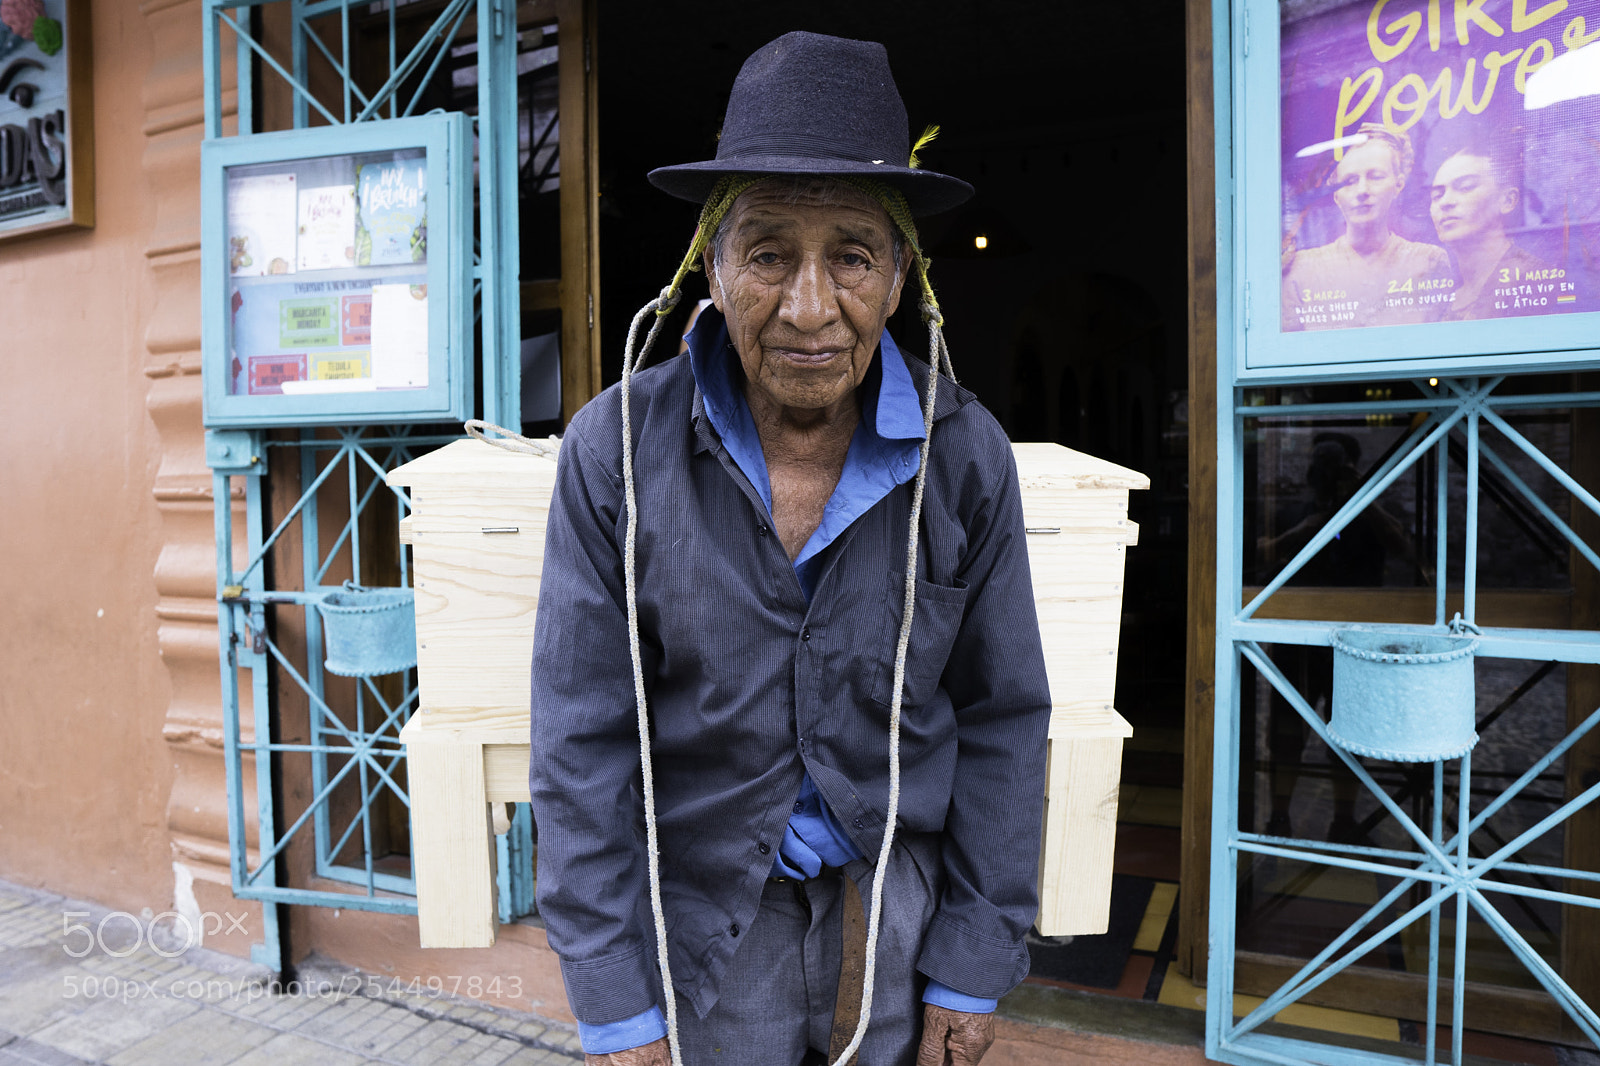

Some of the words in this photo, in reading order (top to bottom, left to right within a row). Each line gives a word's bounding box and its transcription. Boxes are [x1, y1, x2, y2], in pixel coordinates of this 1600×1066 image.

[1498, 267, 1520, 283] 31
[1525, 268, 1566, 281] MARZO
[1387, 277, 1413, 294] 24
[1418, 278, 1454, 290] MARZO
[1494, 284, 1532, 297] FIESTA
[1537, 282, 1555, 294] VIP
[1560, 281, 1575, 292] EN
[1302, 289, 1312, 302] 3
[1313, 290, 1347, 301] MARZO
[1385, 297, 1414, 307] ISHTO
[1418, 292, 1457, 305] JUEVEZ
[1494, 300, 1509, 310] EL
[1513, 295, 1548, 309] ÁTICO
[1295, 305, 1325, 314] BLACK
[1329, 301, 1359, 312] SHEEP
[1299, 314, 1328, 323] BRASS
[1331, 311, 1355, 321] BAND
